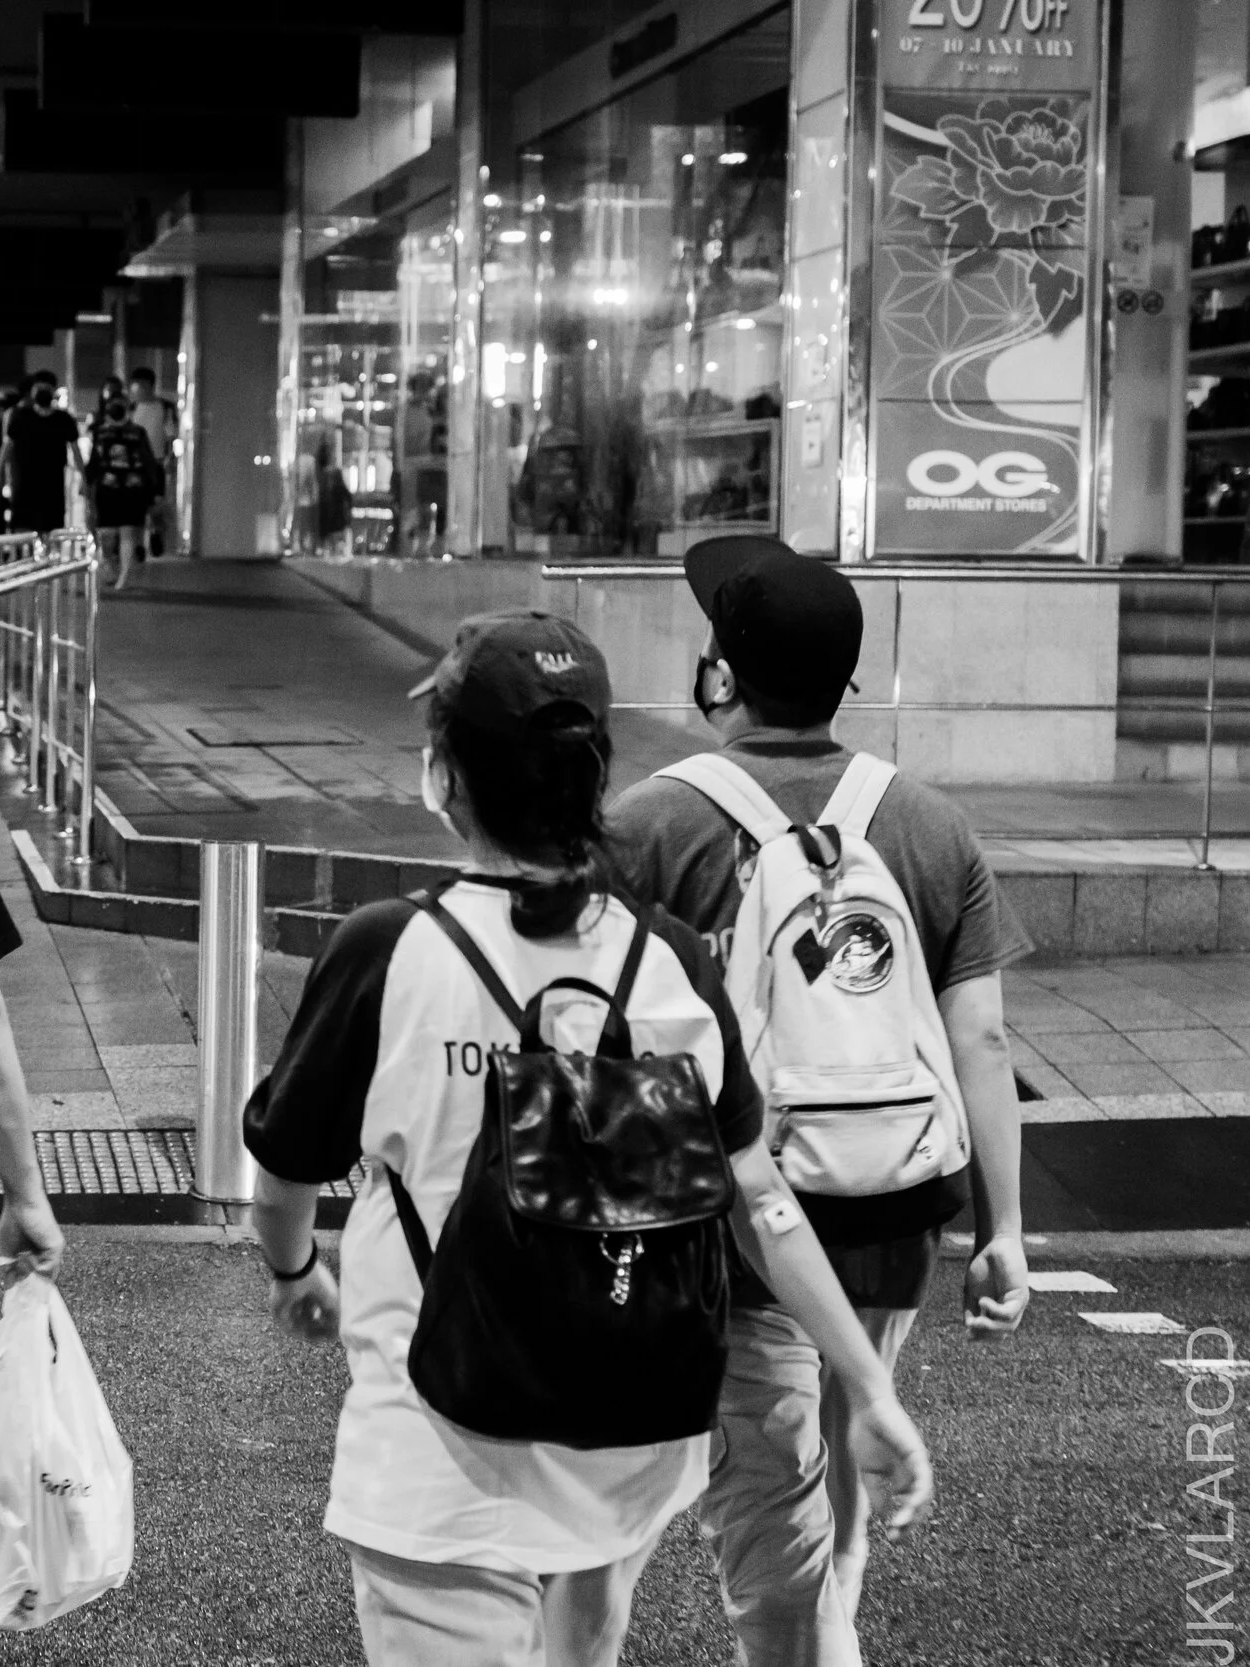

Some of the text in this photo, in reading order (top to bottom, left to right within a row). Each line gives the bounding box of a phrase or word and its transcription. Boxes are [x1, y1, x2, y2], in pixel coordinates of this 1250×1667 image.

[969, 37, 1075, 57] JANUARY
[906, 450, 1048, 497] OG
[905, 496, 1047, 512] DEPARTMENT STORES
